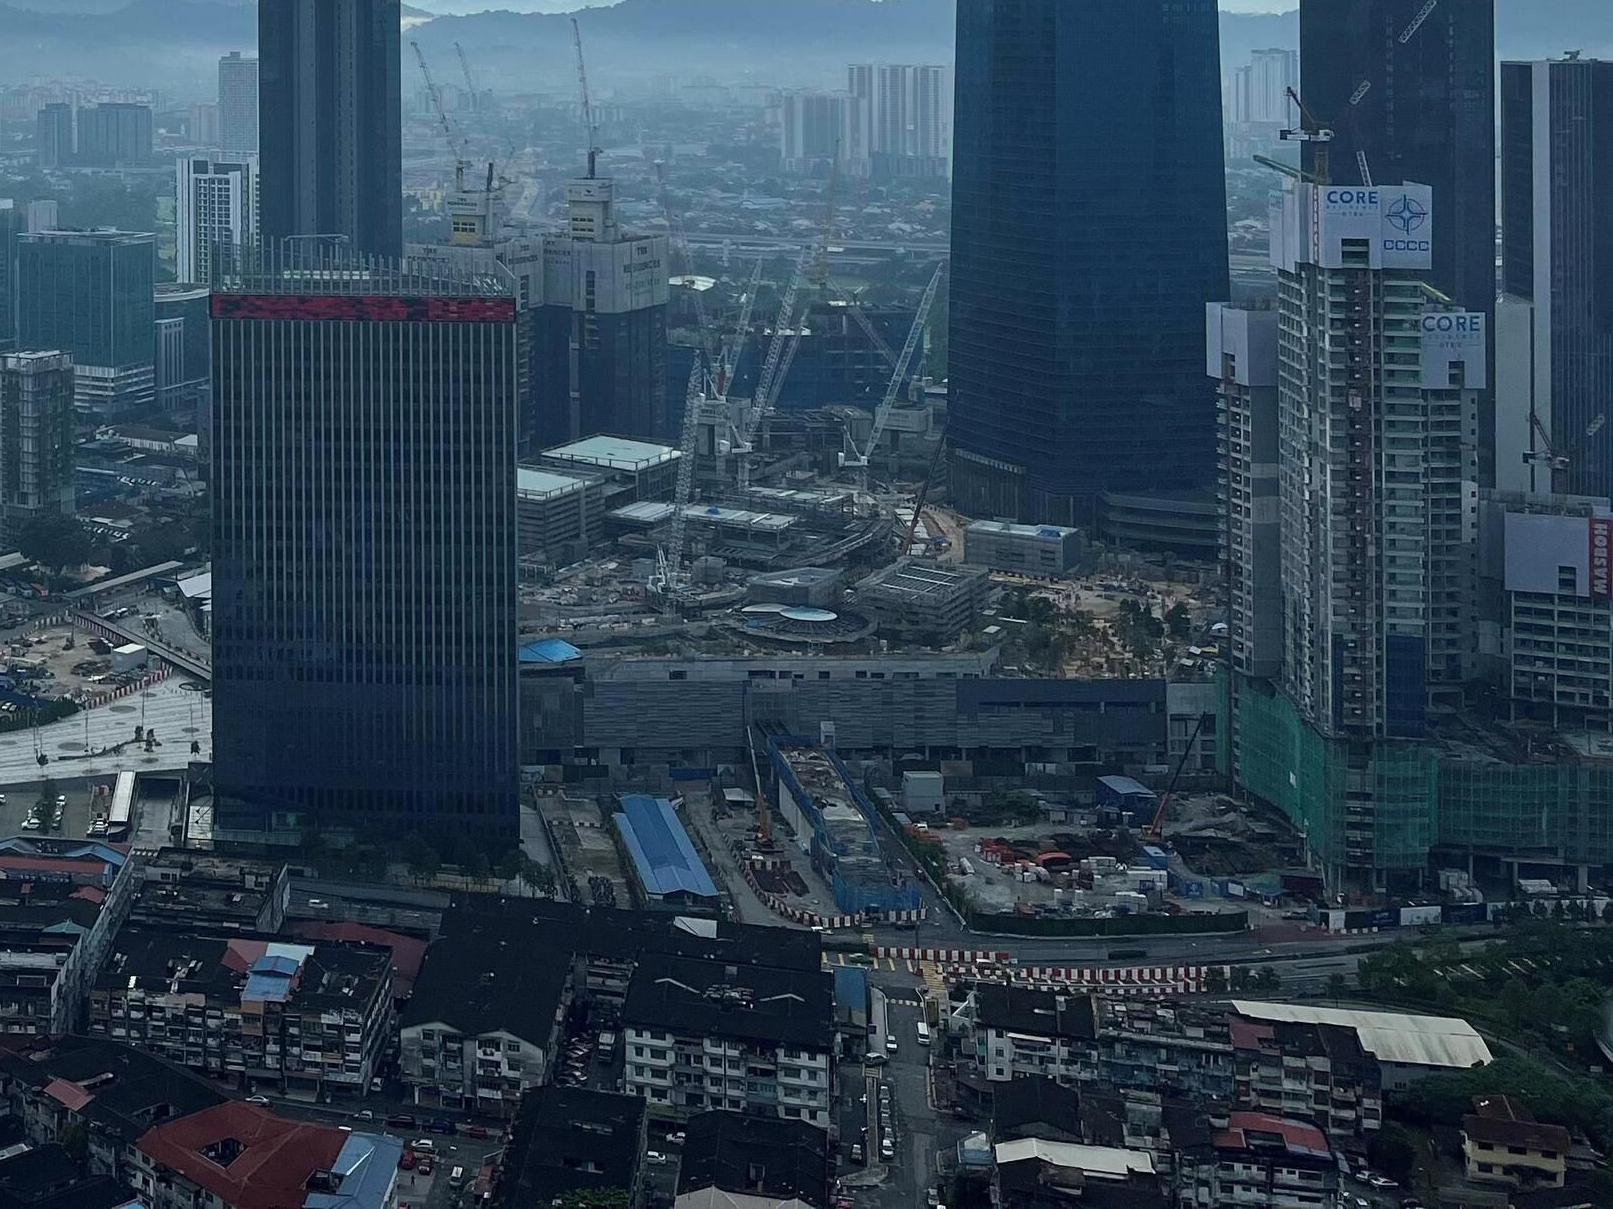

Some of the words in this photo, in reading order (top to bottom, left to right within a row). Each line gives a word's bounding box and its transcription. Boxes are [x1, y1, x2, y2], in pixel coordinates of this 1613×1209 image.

[1327, 190, 1379, 204] CORE
[1383, 240, 1429, 251] CCCC
[1422, 316, 1480, 332] CORE
